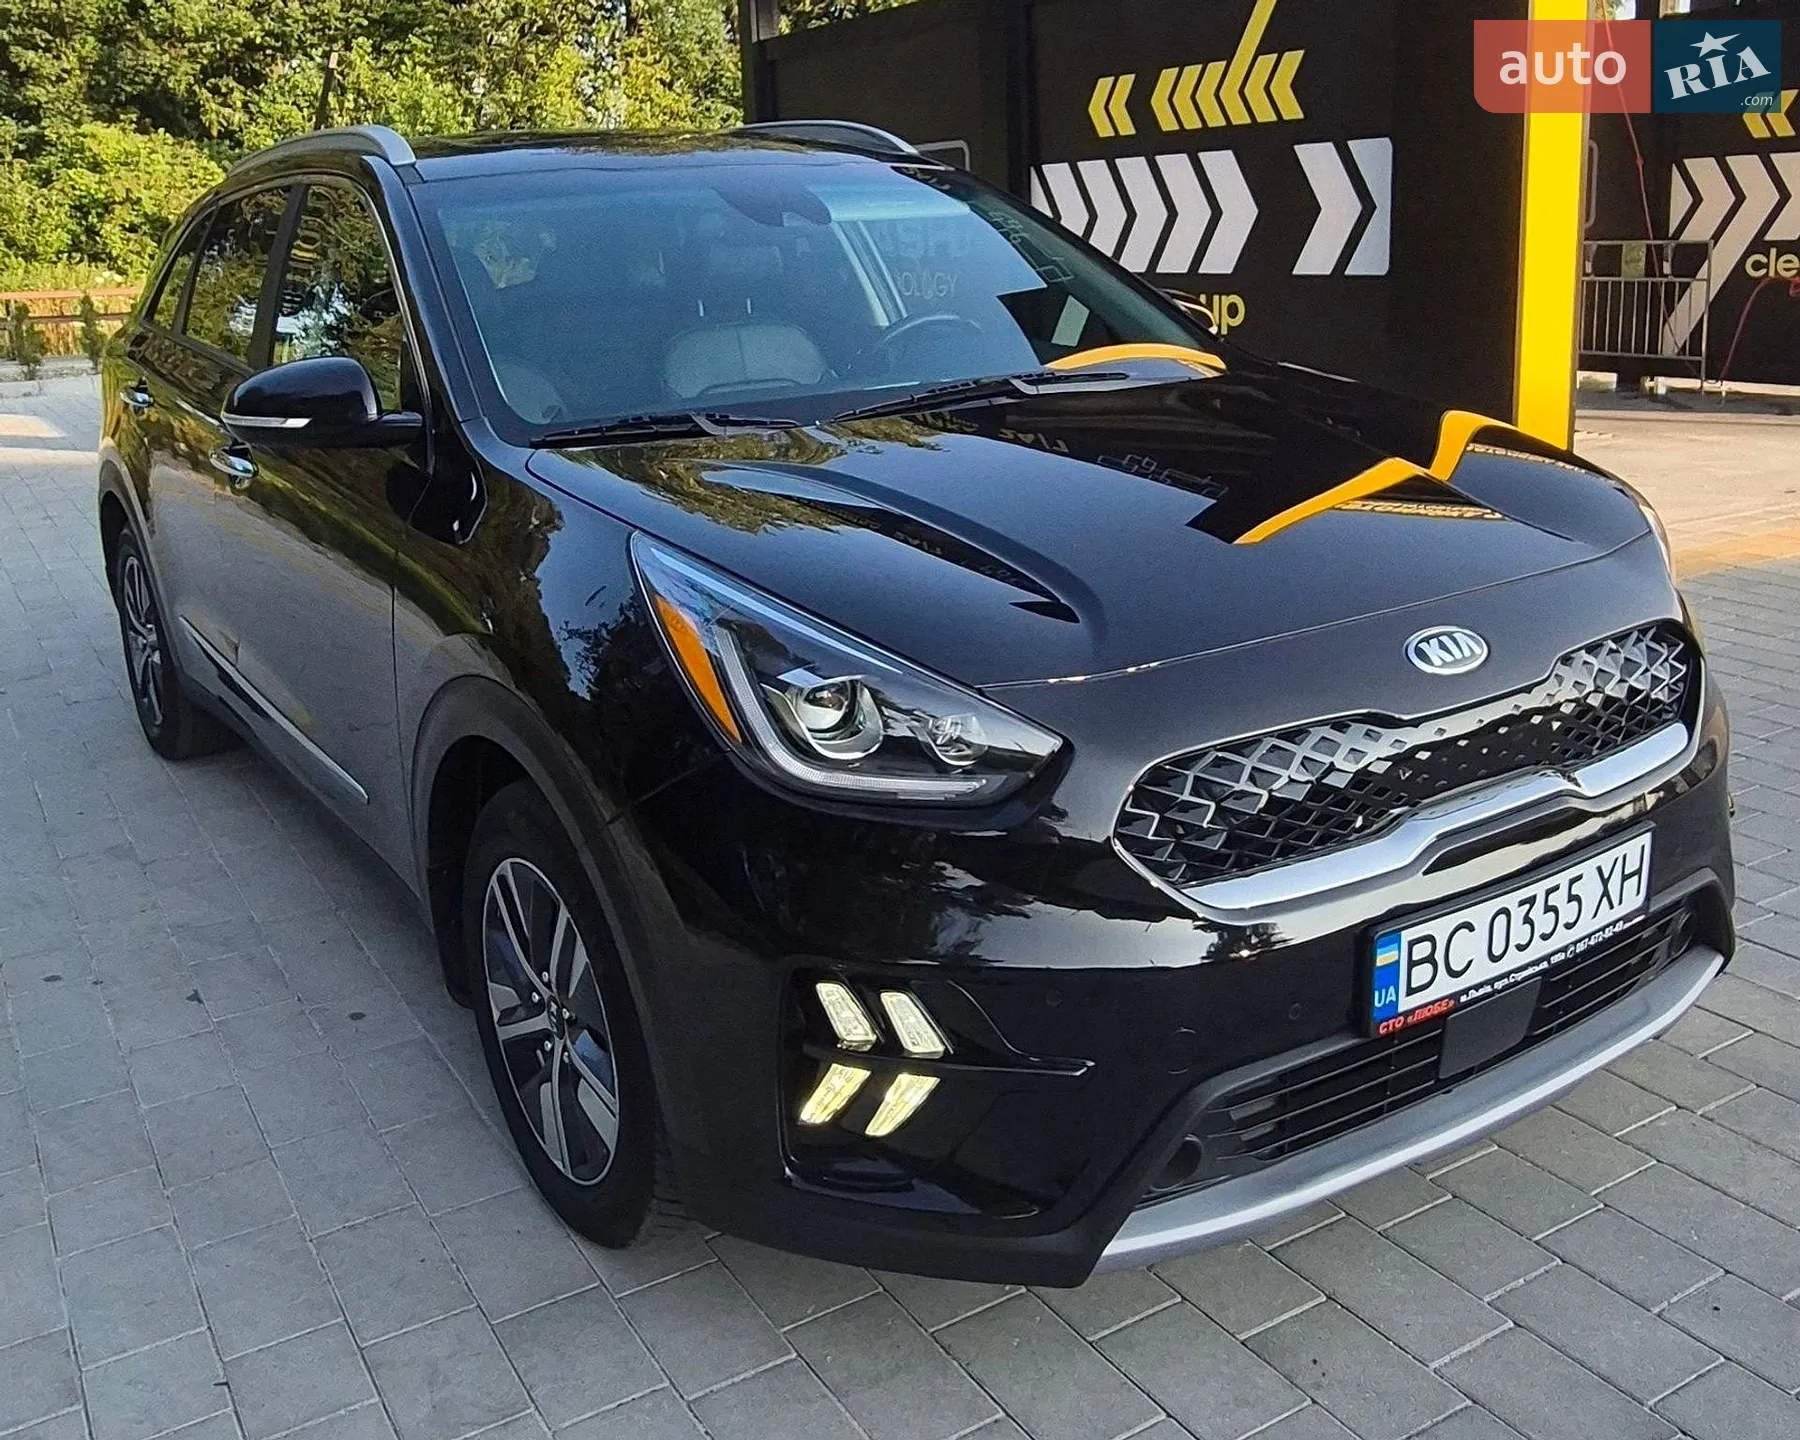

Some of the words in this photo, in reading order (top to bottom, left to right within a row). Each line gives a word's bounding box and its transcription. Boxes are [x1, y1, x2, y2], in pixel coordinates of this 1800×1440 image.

[1417, 632, 1482, 667] KIA
[1405, 920, 1476, 998] BC
[1487, 873, 1585, 964] 0355
[1592, 843, 1646, 920] XH
[1374, 985, 1397, 1008] UA
